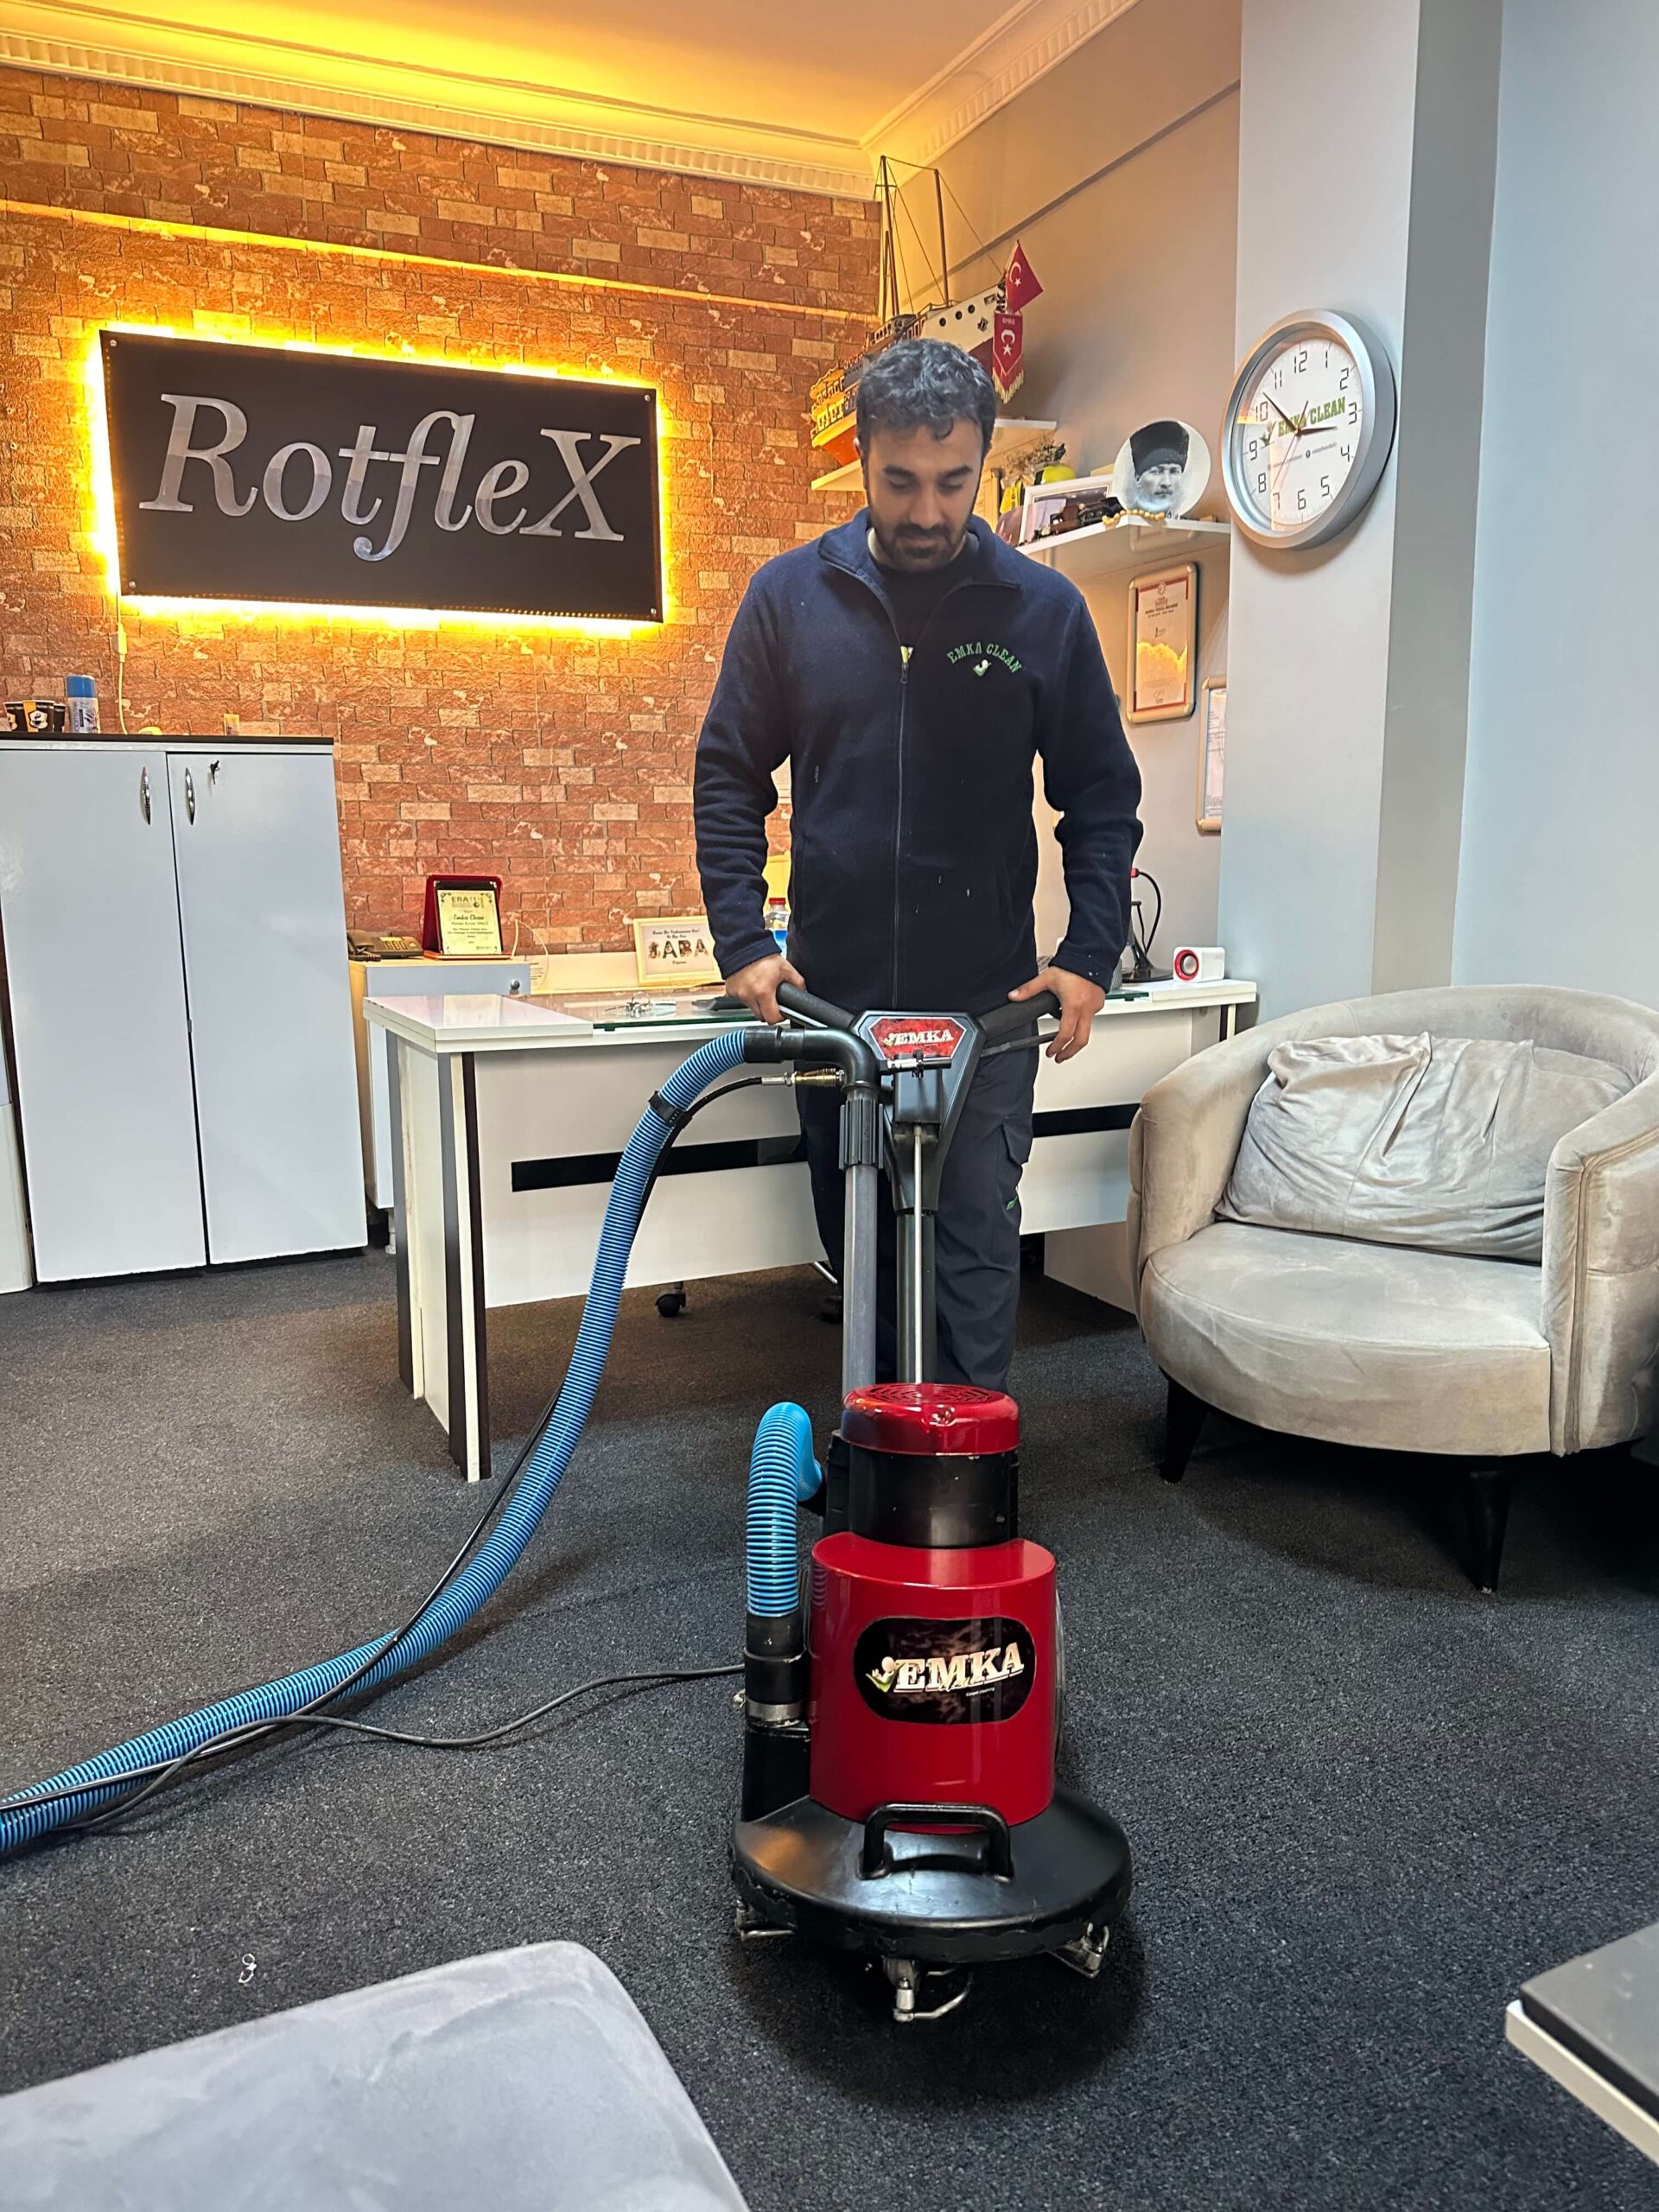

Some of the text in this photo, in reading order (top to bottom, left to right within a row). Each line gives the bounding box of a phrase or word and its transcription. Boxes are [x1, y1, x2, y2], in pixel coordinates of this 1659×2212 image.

[1294, 351, 1307, 373] 12
[1274, 370, 1282, 389] 11
[1339, 367, 1350, 390] 2
[1255, 401, 1268, 422] 10
[1310, 397, 1345, 424] CLEAN
[1348, 402, 1357, 425] 3
[1249, 440, 1257, 461] 9
[1340, 445, 1351, 462] 4
[1258, 473, 1267, 493] 8
[1320, 475, 1330, 497] 5
[1273, 493, 1281, 510] 7
[1298, 489, 1306, 511] 6
[947, 641, 1022, 673] EMKA CLEAN
[893, 1029, 954, 1046] EMKA
[893, 1642, 1025, 1692] EMKA
